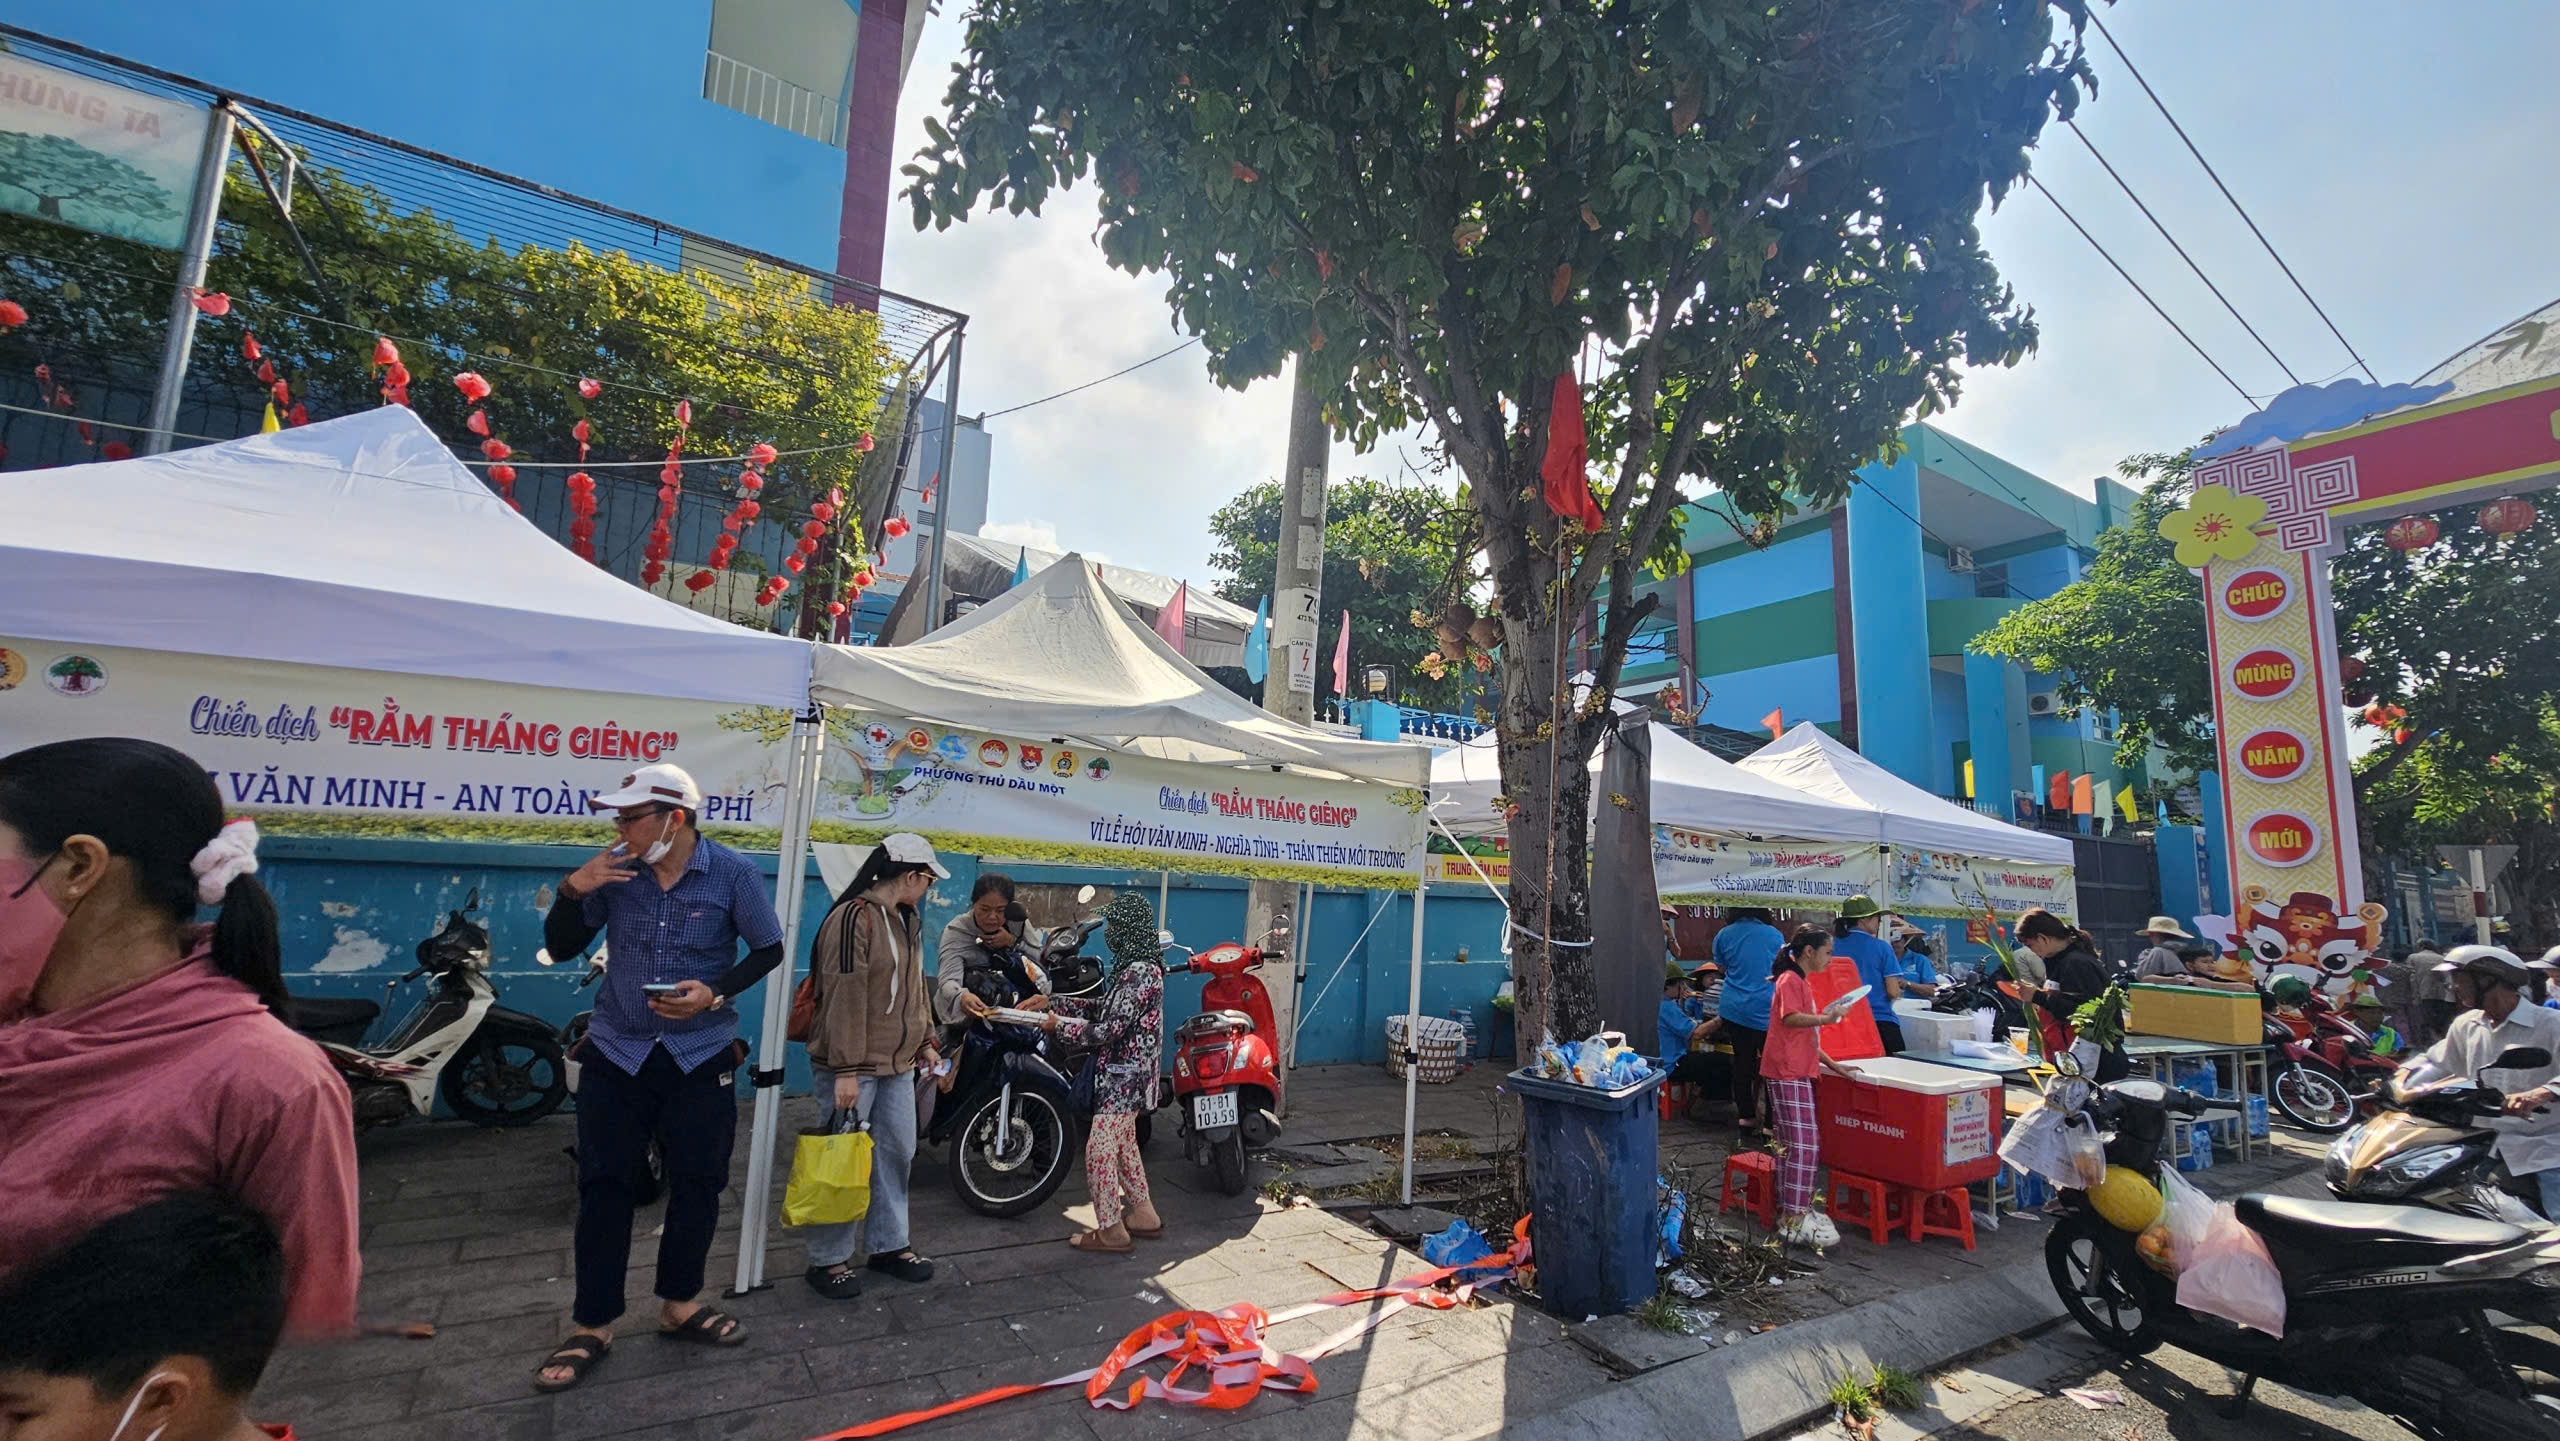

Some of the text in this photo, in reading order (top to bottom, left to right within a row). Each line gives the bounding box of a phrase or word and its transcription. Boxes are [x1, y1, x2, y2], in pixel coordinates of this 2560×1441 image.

[122, 105, 161, 138] TA
[2228, 580, 2284, 607] CHÚC
[2235, 663, 2293, 686] MỪNG
[190, 695, 679, 762] Chiến dịch “RẰM THÁNG GIÊNG”
[2247, 745, 2298, 767] NĂM
[229, 765, 316, 805] VĂN
[323, 777, 426, 809] MINH
[452, 784, 504, 813] AN
[512, 780, 600, 816] TOÀN
[706, 789, 755, 822] PHÍ
[914, 766, 1066, 797] PHƯỜNG THỦ DẦU MỘT
[1159, 785, 1187, 812] Chiến
[1187, 790, 1209, 816] dịch
[1256, 795, 1307, 824] THÁNG
[1309, 801, 1358, 828] GIÊNG”
[1090, 816, 1106, 842] VÌ
[1105, 814, 1123, 844] LỄ
[1123, 820, 1147, 850] HỘI
[1149, 824, 1175, 849] VĂN
[1175, 831, 1209, 852] MINH
[1215, 834, 1251, 857] NGHĨA
[1253, 835, 1280, 860] TÌNH
[1286, 839, 1315, 863] THÂN
[1316, 841, 1347, 869] THIỆN
[1349, 843, 1368, 866] MÔI
[1368, 845, 1406, 869] TRƯỜNG
[2259, 828, 2303, 849] MỚI
[1446, 862, 1472, 876] TRUNG
[1776, 875, 1795, 893] TÌNH
[1814, 881, 1833, 896] MINH
[2347, 1272, 2427, 1287] ULTIMO
